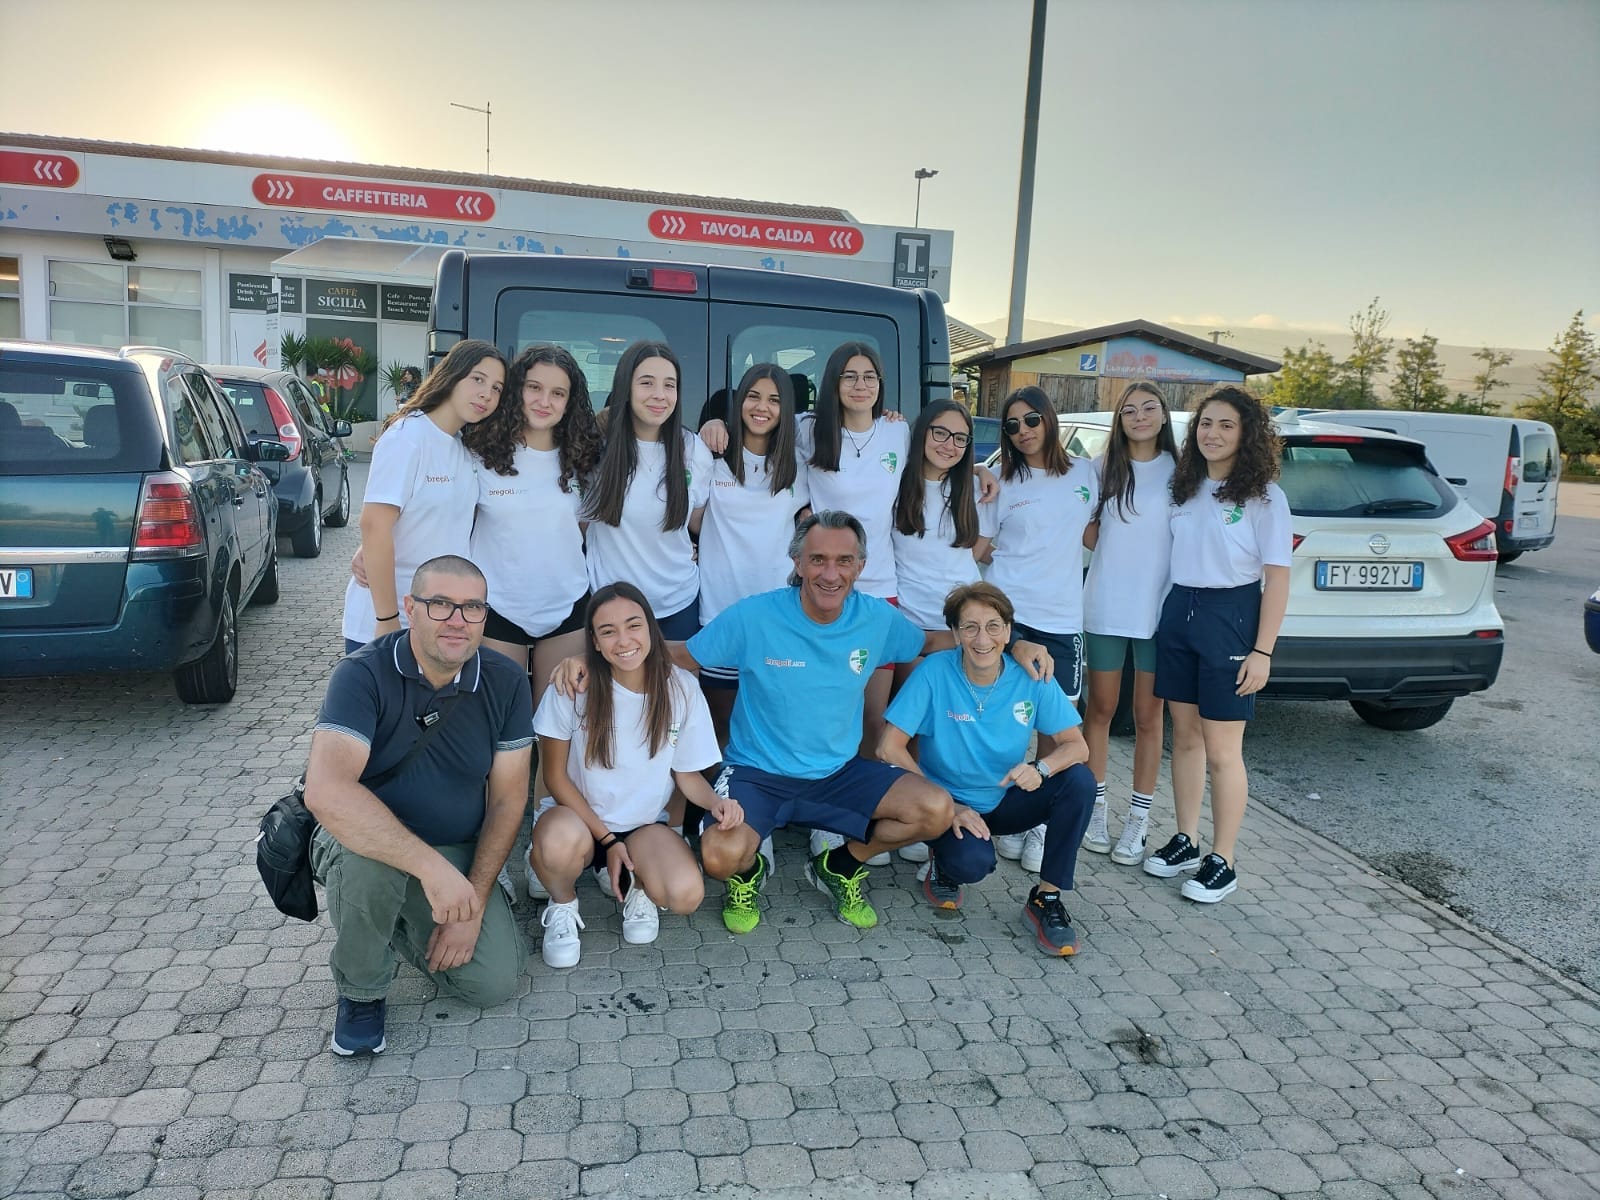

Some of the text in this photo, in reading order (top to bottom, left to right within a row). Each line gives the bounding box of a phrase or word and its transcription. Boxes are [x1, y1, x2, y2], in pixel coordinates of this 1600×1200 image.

[322, 187, 428, 208] CAFFETTERIA
[701, 221, 814, 244] TAVOLA CALDA
[901, 238, 925, 274] T
[327, 287, 358, 297] CAFFÈ
[897, 279, 926, 288] TABACCHI
[318, 296, 367, 310] SICILIA
[1329, 565, 1412, 585] FY 992YJ
